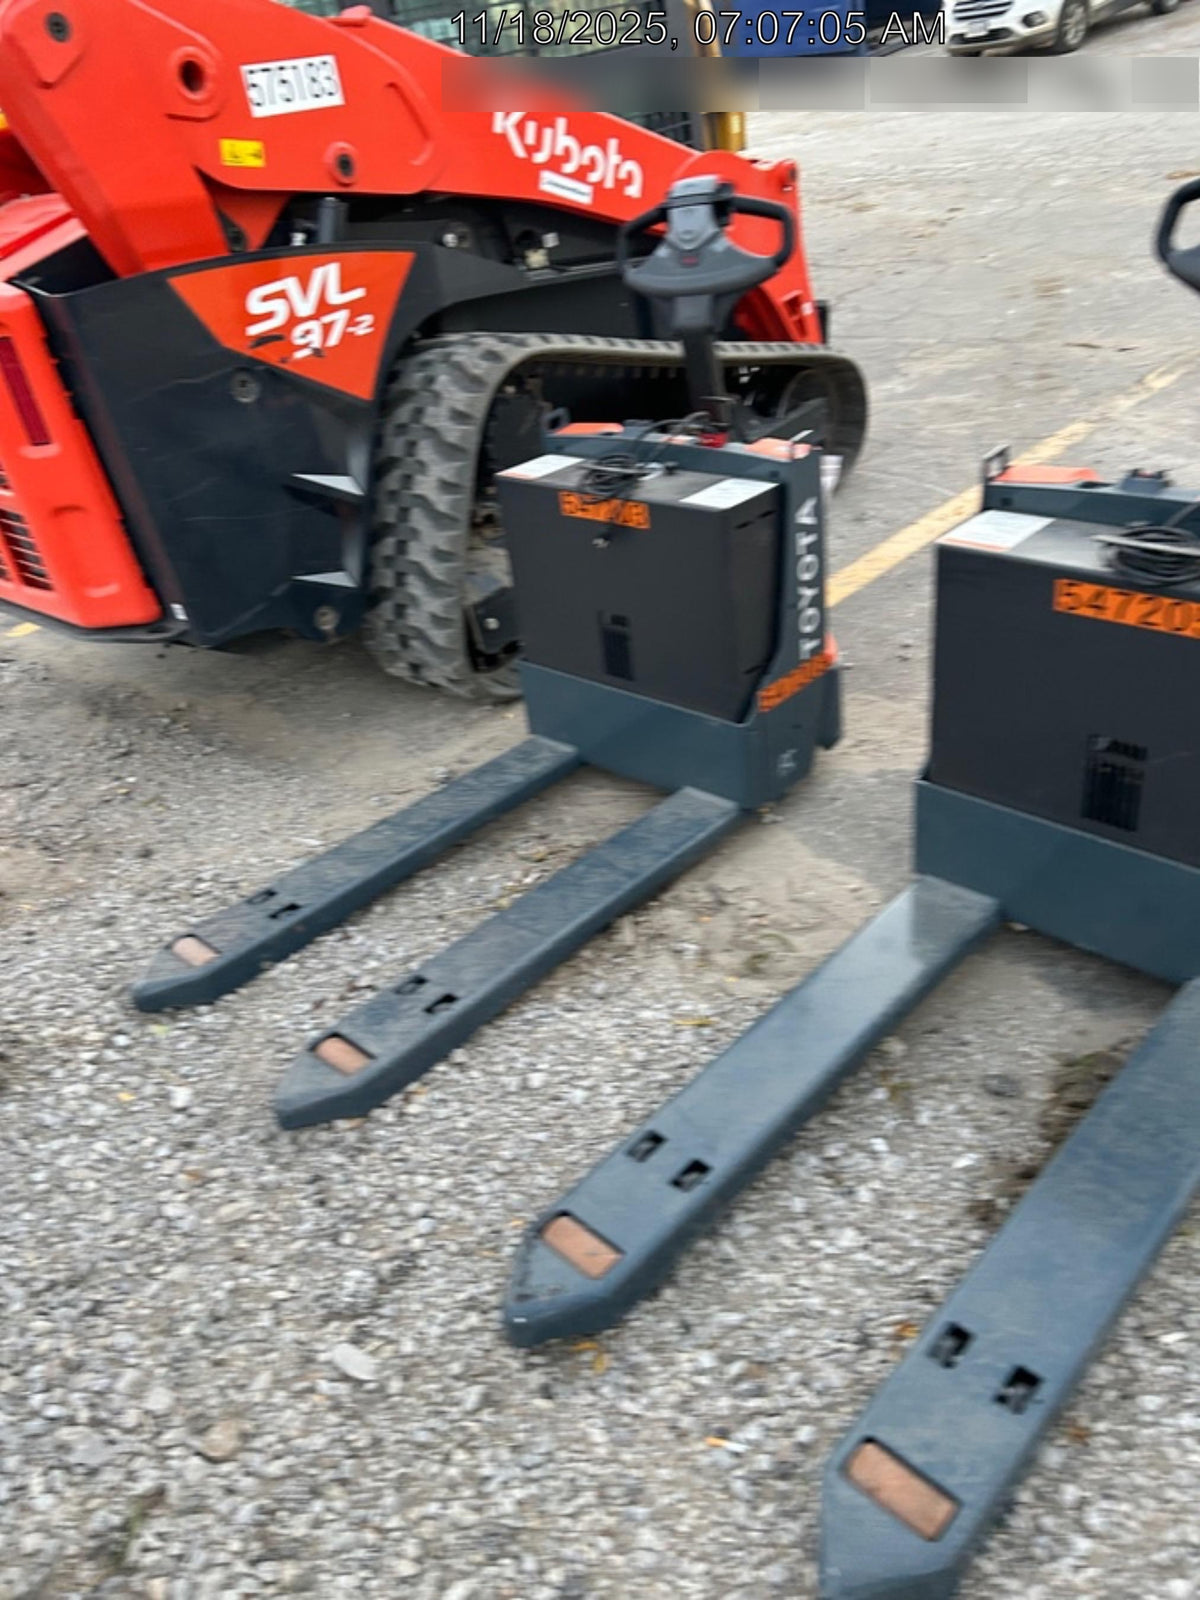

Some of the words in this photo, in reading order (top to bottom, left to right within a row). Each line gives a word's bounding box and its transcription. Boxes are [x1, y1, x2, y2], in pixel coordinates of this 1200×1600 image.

[245, 60, 338, 107] 575183
[492, 112, 643, 198] Kubota
[245, 262, 367, 336] SVL
[290, 308, 375, 359] 97-2
[794, 496, 821, 660] TOYOTA
